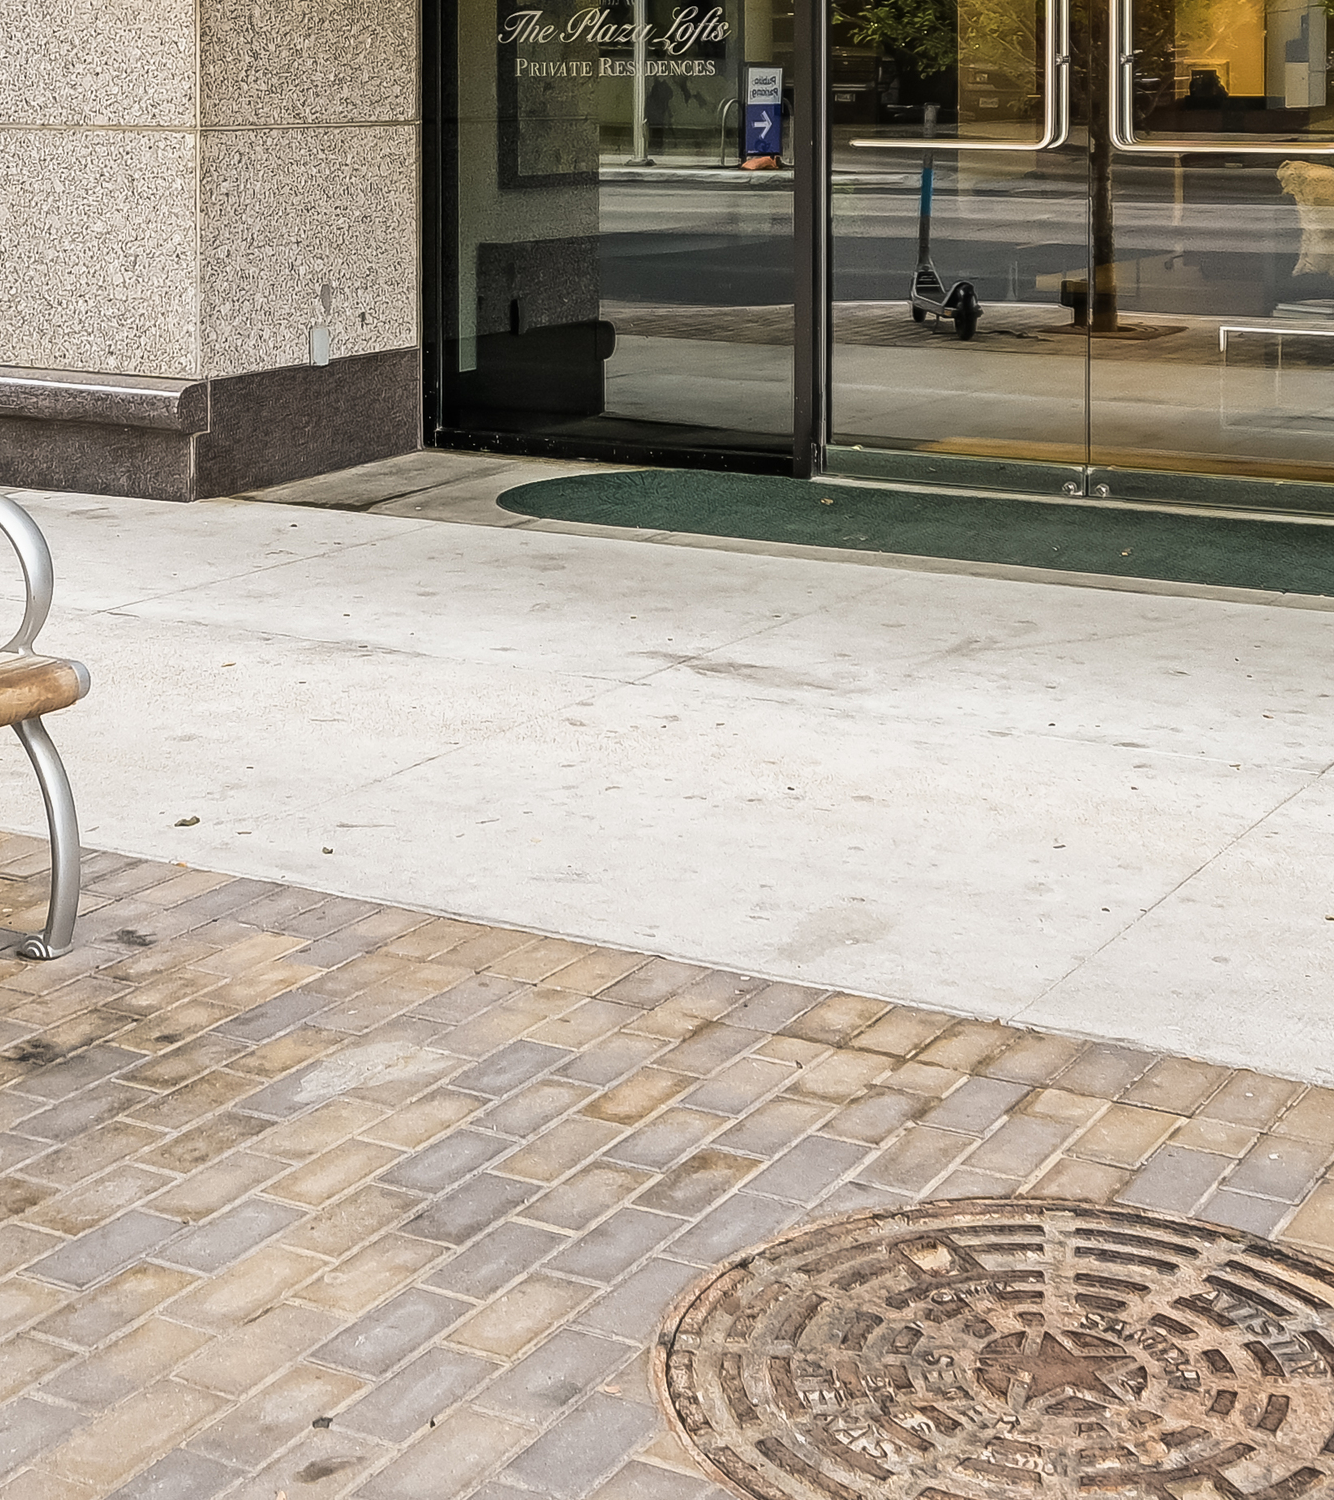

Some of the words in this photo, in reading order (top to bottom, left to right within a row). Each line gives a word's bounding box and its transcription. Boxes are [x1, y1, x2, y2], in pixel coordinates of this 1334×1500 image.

[497, 10, 559, 45] The
[560, 6, 657, 44] Plaza
[652, 6, 732, 56] Lofts
[514, 57, 593, 77] PRIVATE
[598, 57, 717, 77] RESIDENCES
